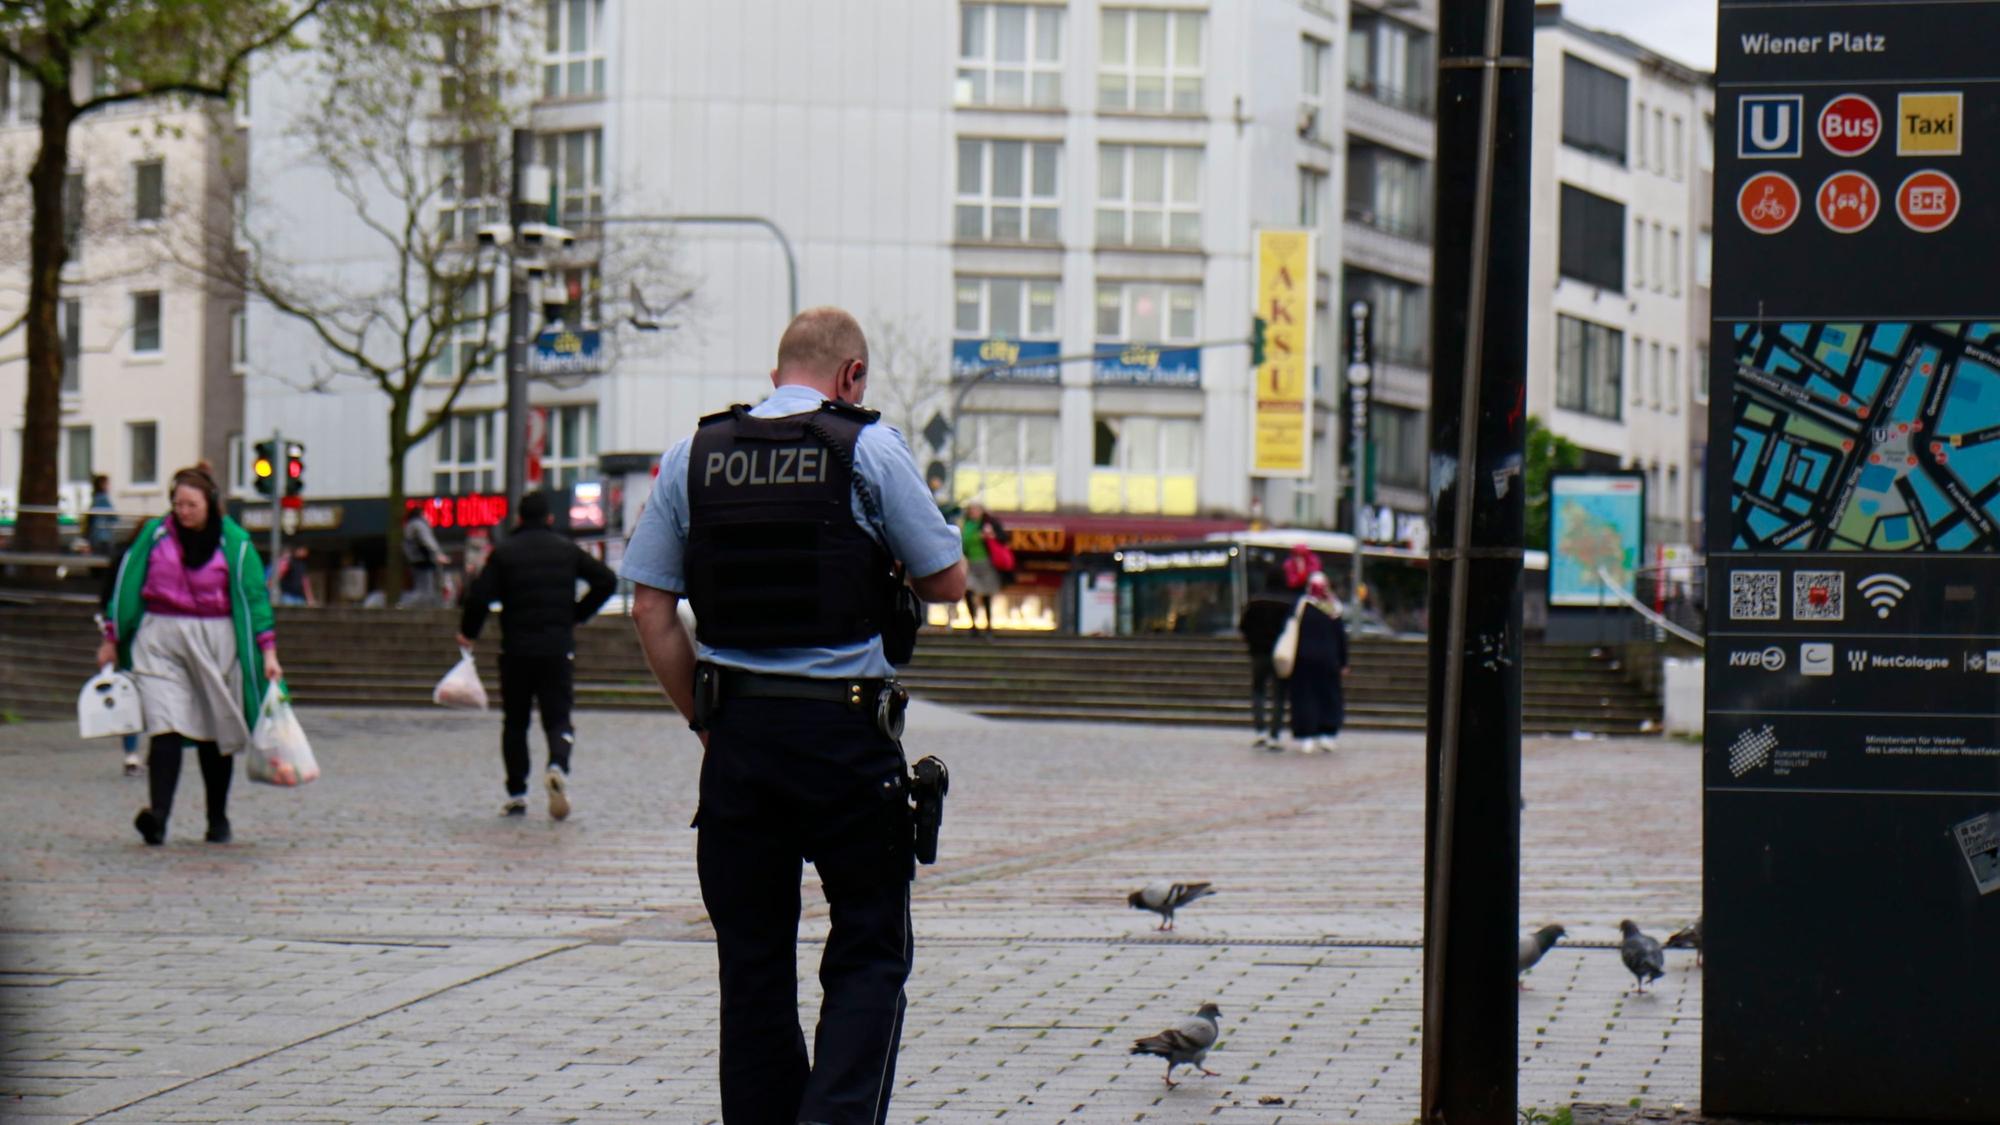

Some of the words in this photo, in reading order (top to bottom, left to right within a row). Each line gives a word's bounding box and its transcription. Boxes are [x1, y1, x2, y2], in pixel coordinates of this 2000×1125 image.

[1741, 34, 1822, 54] Wiener
[1828, 32, 1886, 52] Platz
[1751, 104, 1790, 150] U
[1825, 113, 1875, 138] Bus
[1906, 113, 1954, 135] Taxi
[1270, 264, 1295, 394] AKSU
[704, 448, 828, 487] POLIZEI
[1011, 529, 1066, 551] KSU
[1729, 651, 1761, 666] KVB
[1872, 655, 1950, 670] NetCologne
[1865, 736, 1917, 745] Ministerium
[1918, 735, 1932, 745] für
[1865, 746, 1881, 754] des
[1883, 746, 1914, 755] Landes
